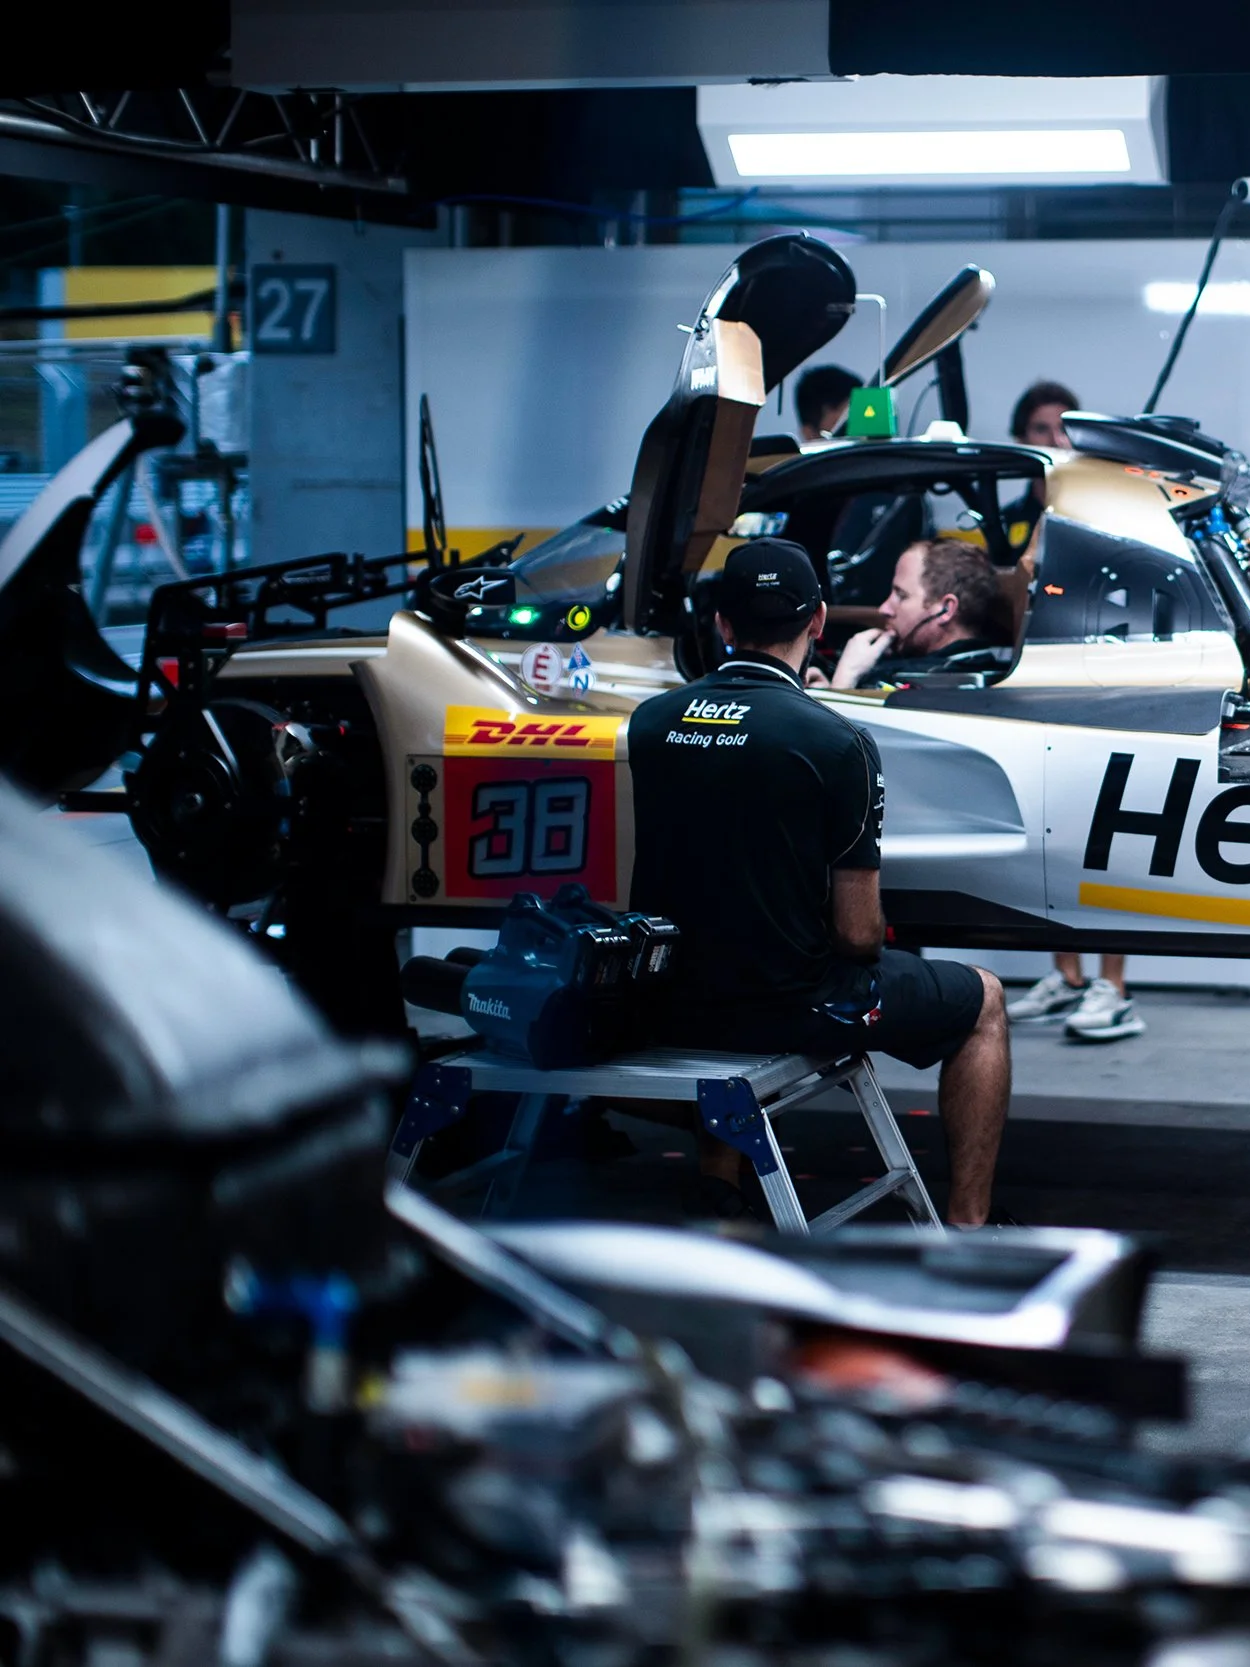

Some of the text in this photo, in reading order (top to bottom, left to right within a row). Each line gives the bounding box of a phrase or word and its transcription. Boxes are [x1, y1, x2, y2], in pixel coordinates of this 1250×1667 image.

[258, 279, 328, 340] 27
[684, 699, 751, 720] Hertz
[467, 720, 591, 747] DHL
[666, 731, 748, 748] Racing Gold
[467, 776, 592, 880] 38
[467, 992, 511, 1020] Makita
